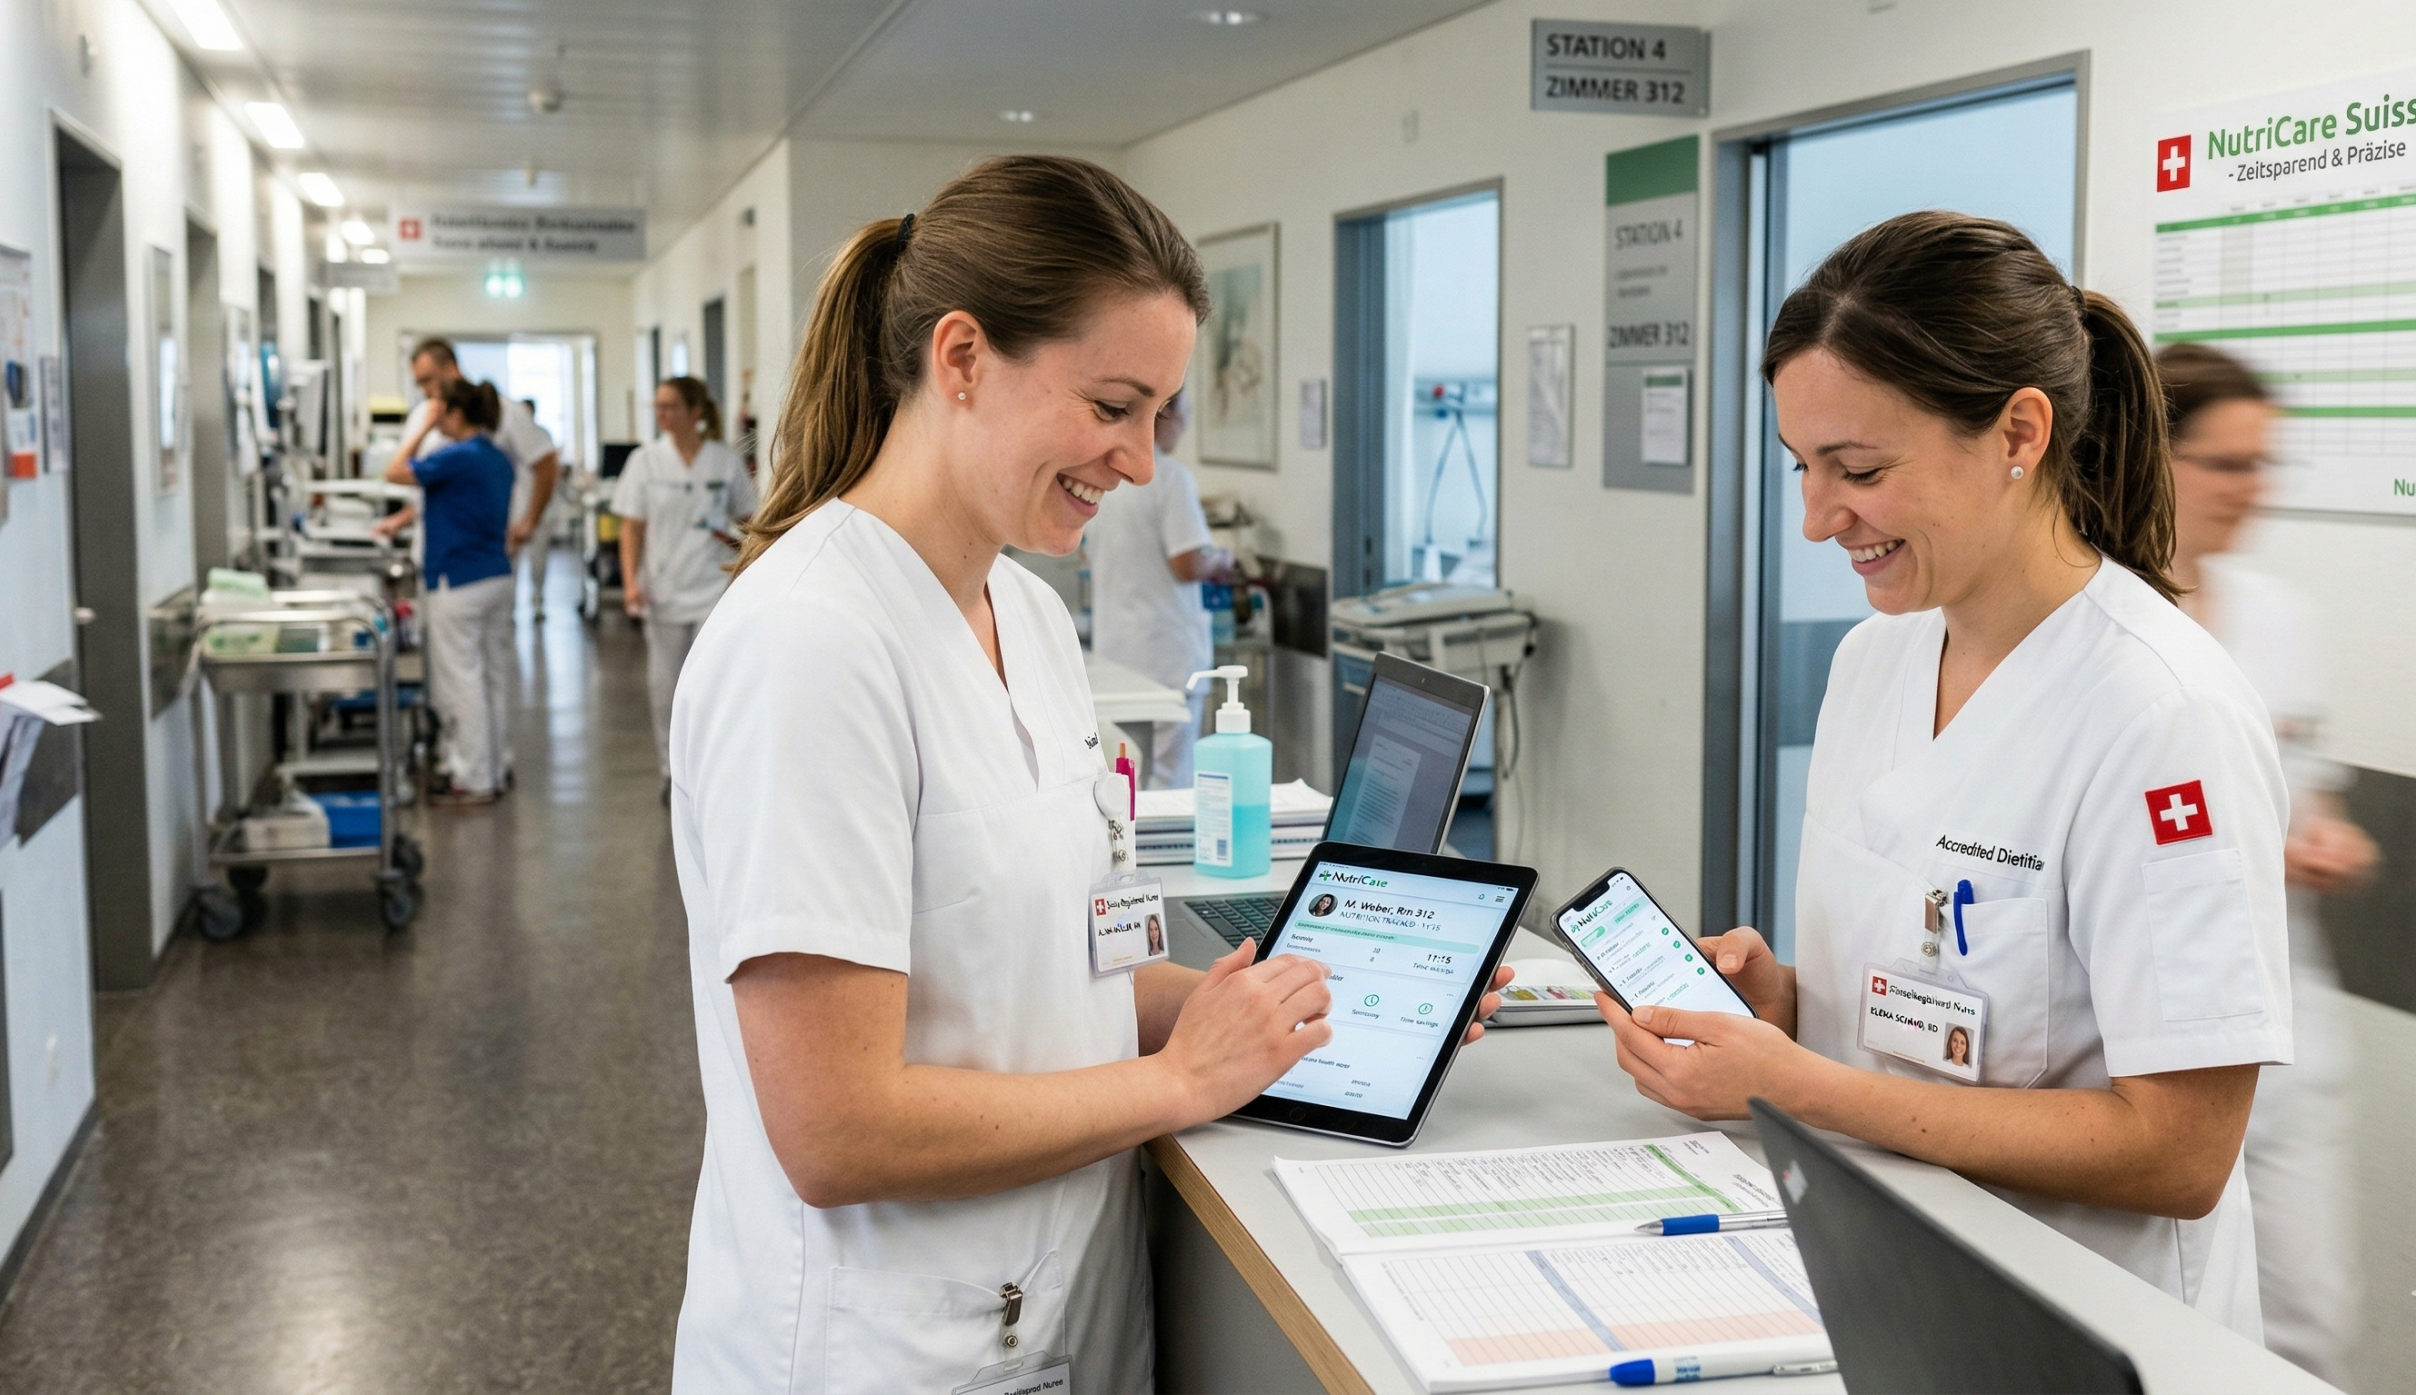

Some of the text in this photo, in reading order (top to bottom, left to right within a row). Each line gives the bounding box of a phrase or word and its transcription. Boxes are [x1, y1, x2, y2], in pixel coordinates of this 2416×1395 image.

[1546, 33, 1667, 61] STATION 4
[1546, 76, 1686, 104] ZIMMER 312
[2207, 113, 2338, 160] NutriCare
[2237, 152, 2328, 183] Zeitsparend
[2331, 148, 2343, 168] &
[2347, 140, 2407, 164] Präzise
[1615, 218, 1683, 249] STATION 4
[1608, 320, 1690, 349] ZIMMER 312
[1415, 908, 1435, 920] 312
